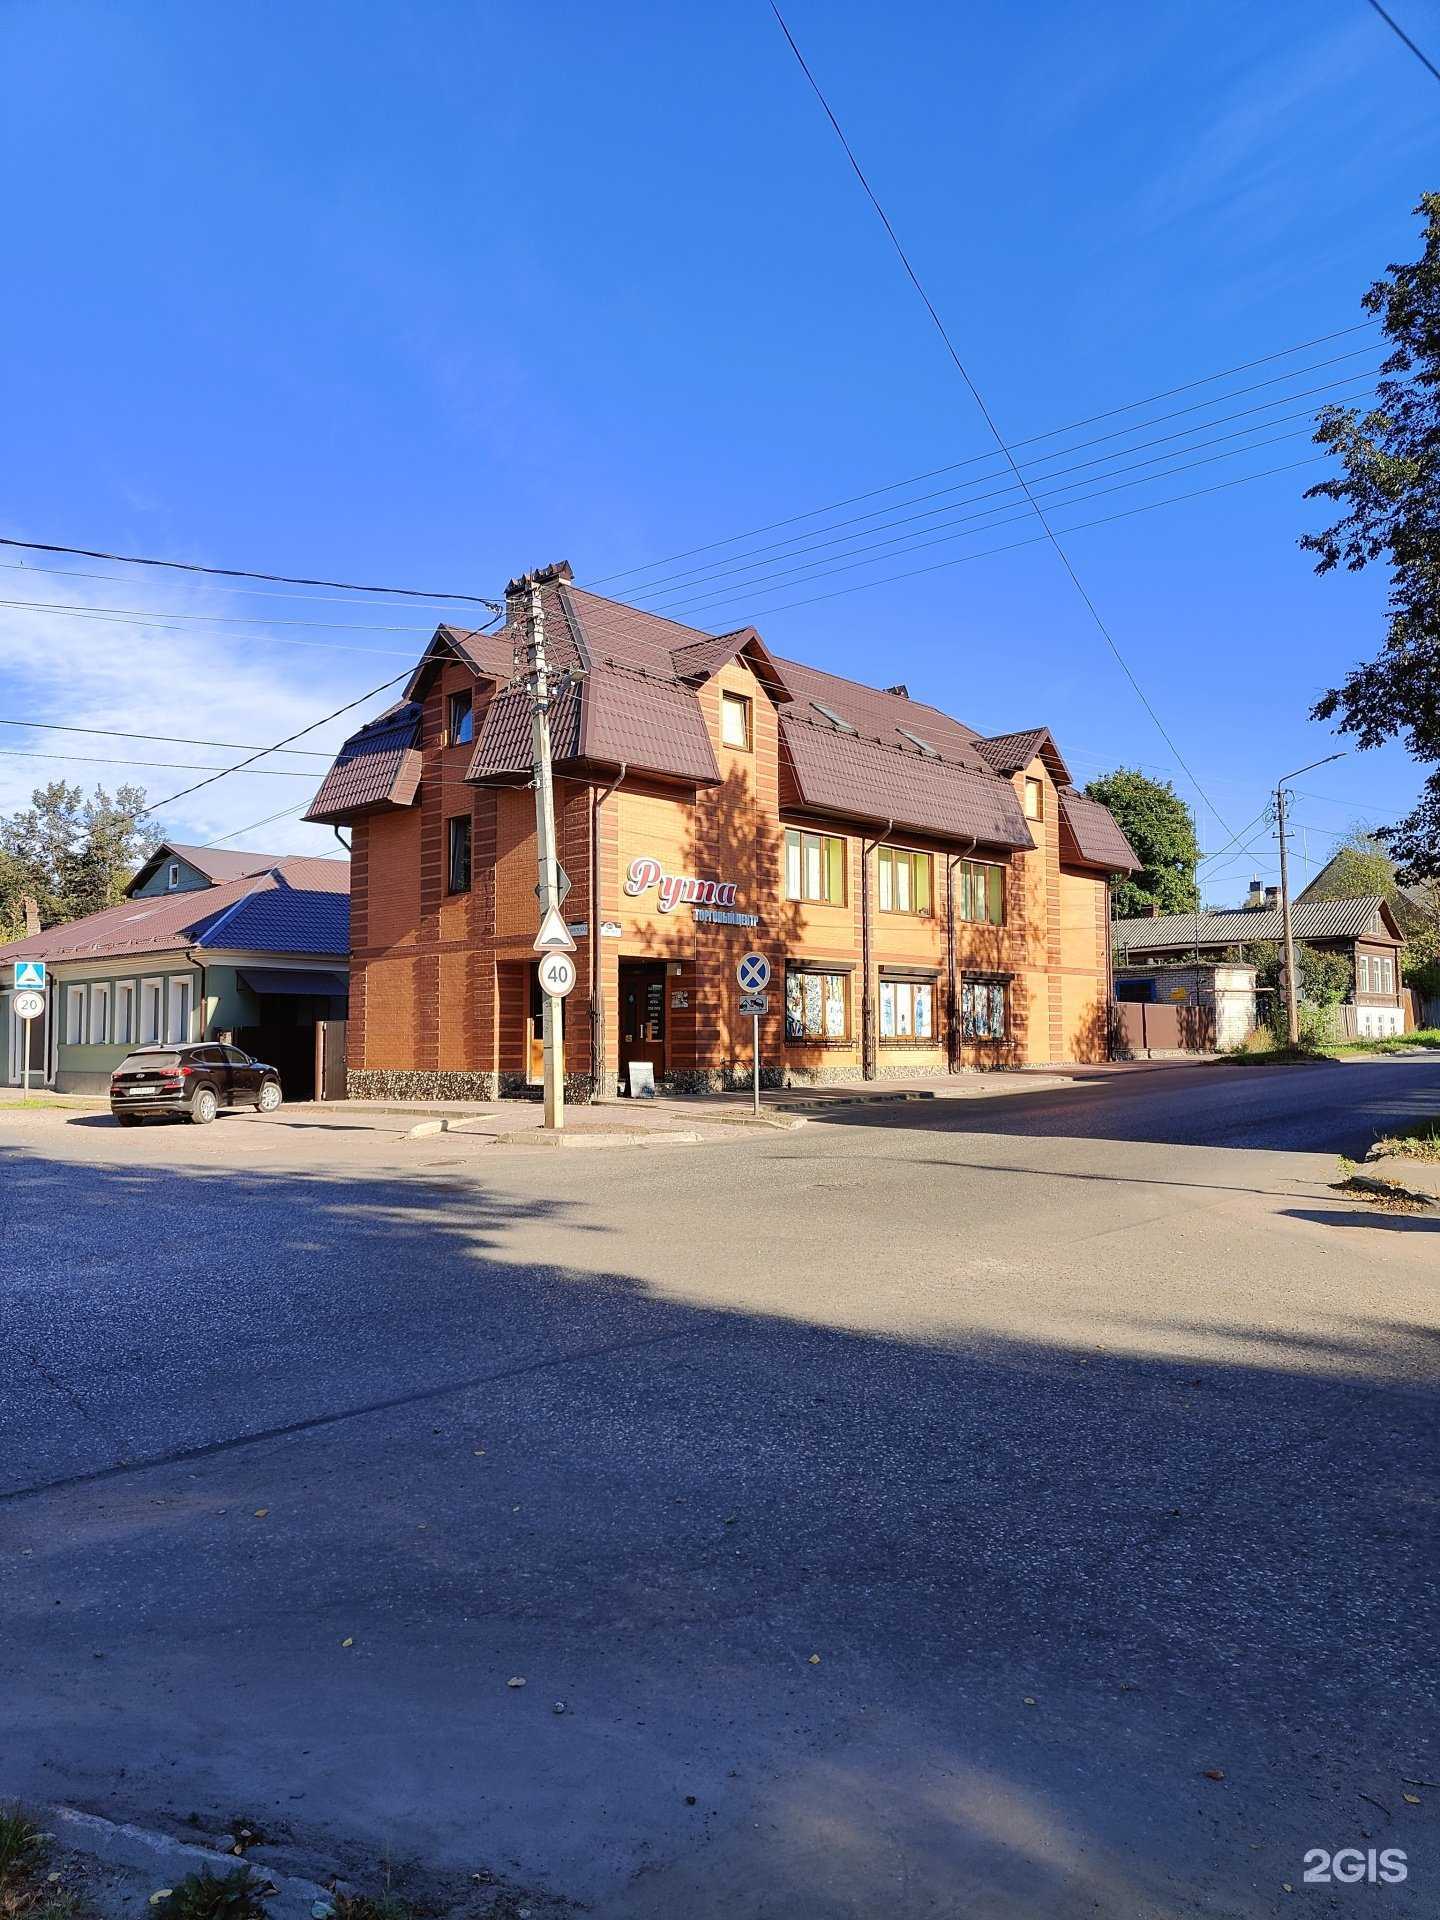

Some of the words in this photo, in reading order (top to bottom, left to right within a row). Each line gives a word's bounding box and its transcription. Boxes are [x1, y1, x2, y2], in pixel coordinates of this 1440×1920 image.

[624, 856, 737, 913] Рута
[692, 908, 735, 925] ТОРГОВЫЙ
[735, 912, 759, 927] ЦЕНТР
[547, 965, 568, 984] 40
[21, 999, 38, 1010] 20
